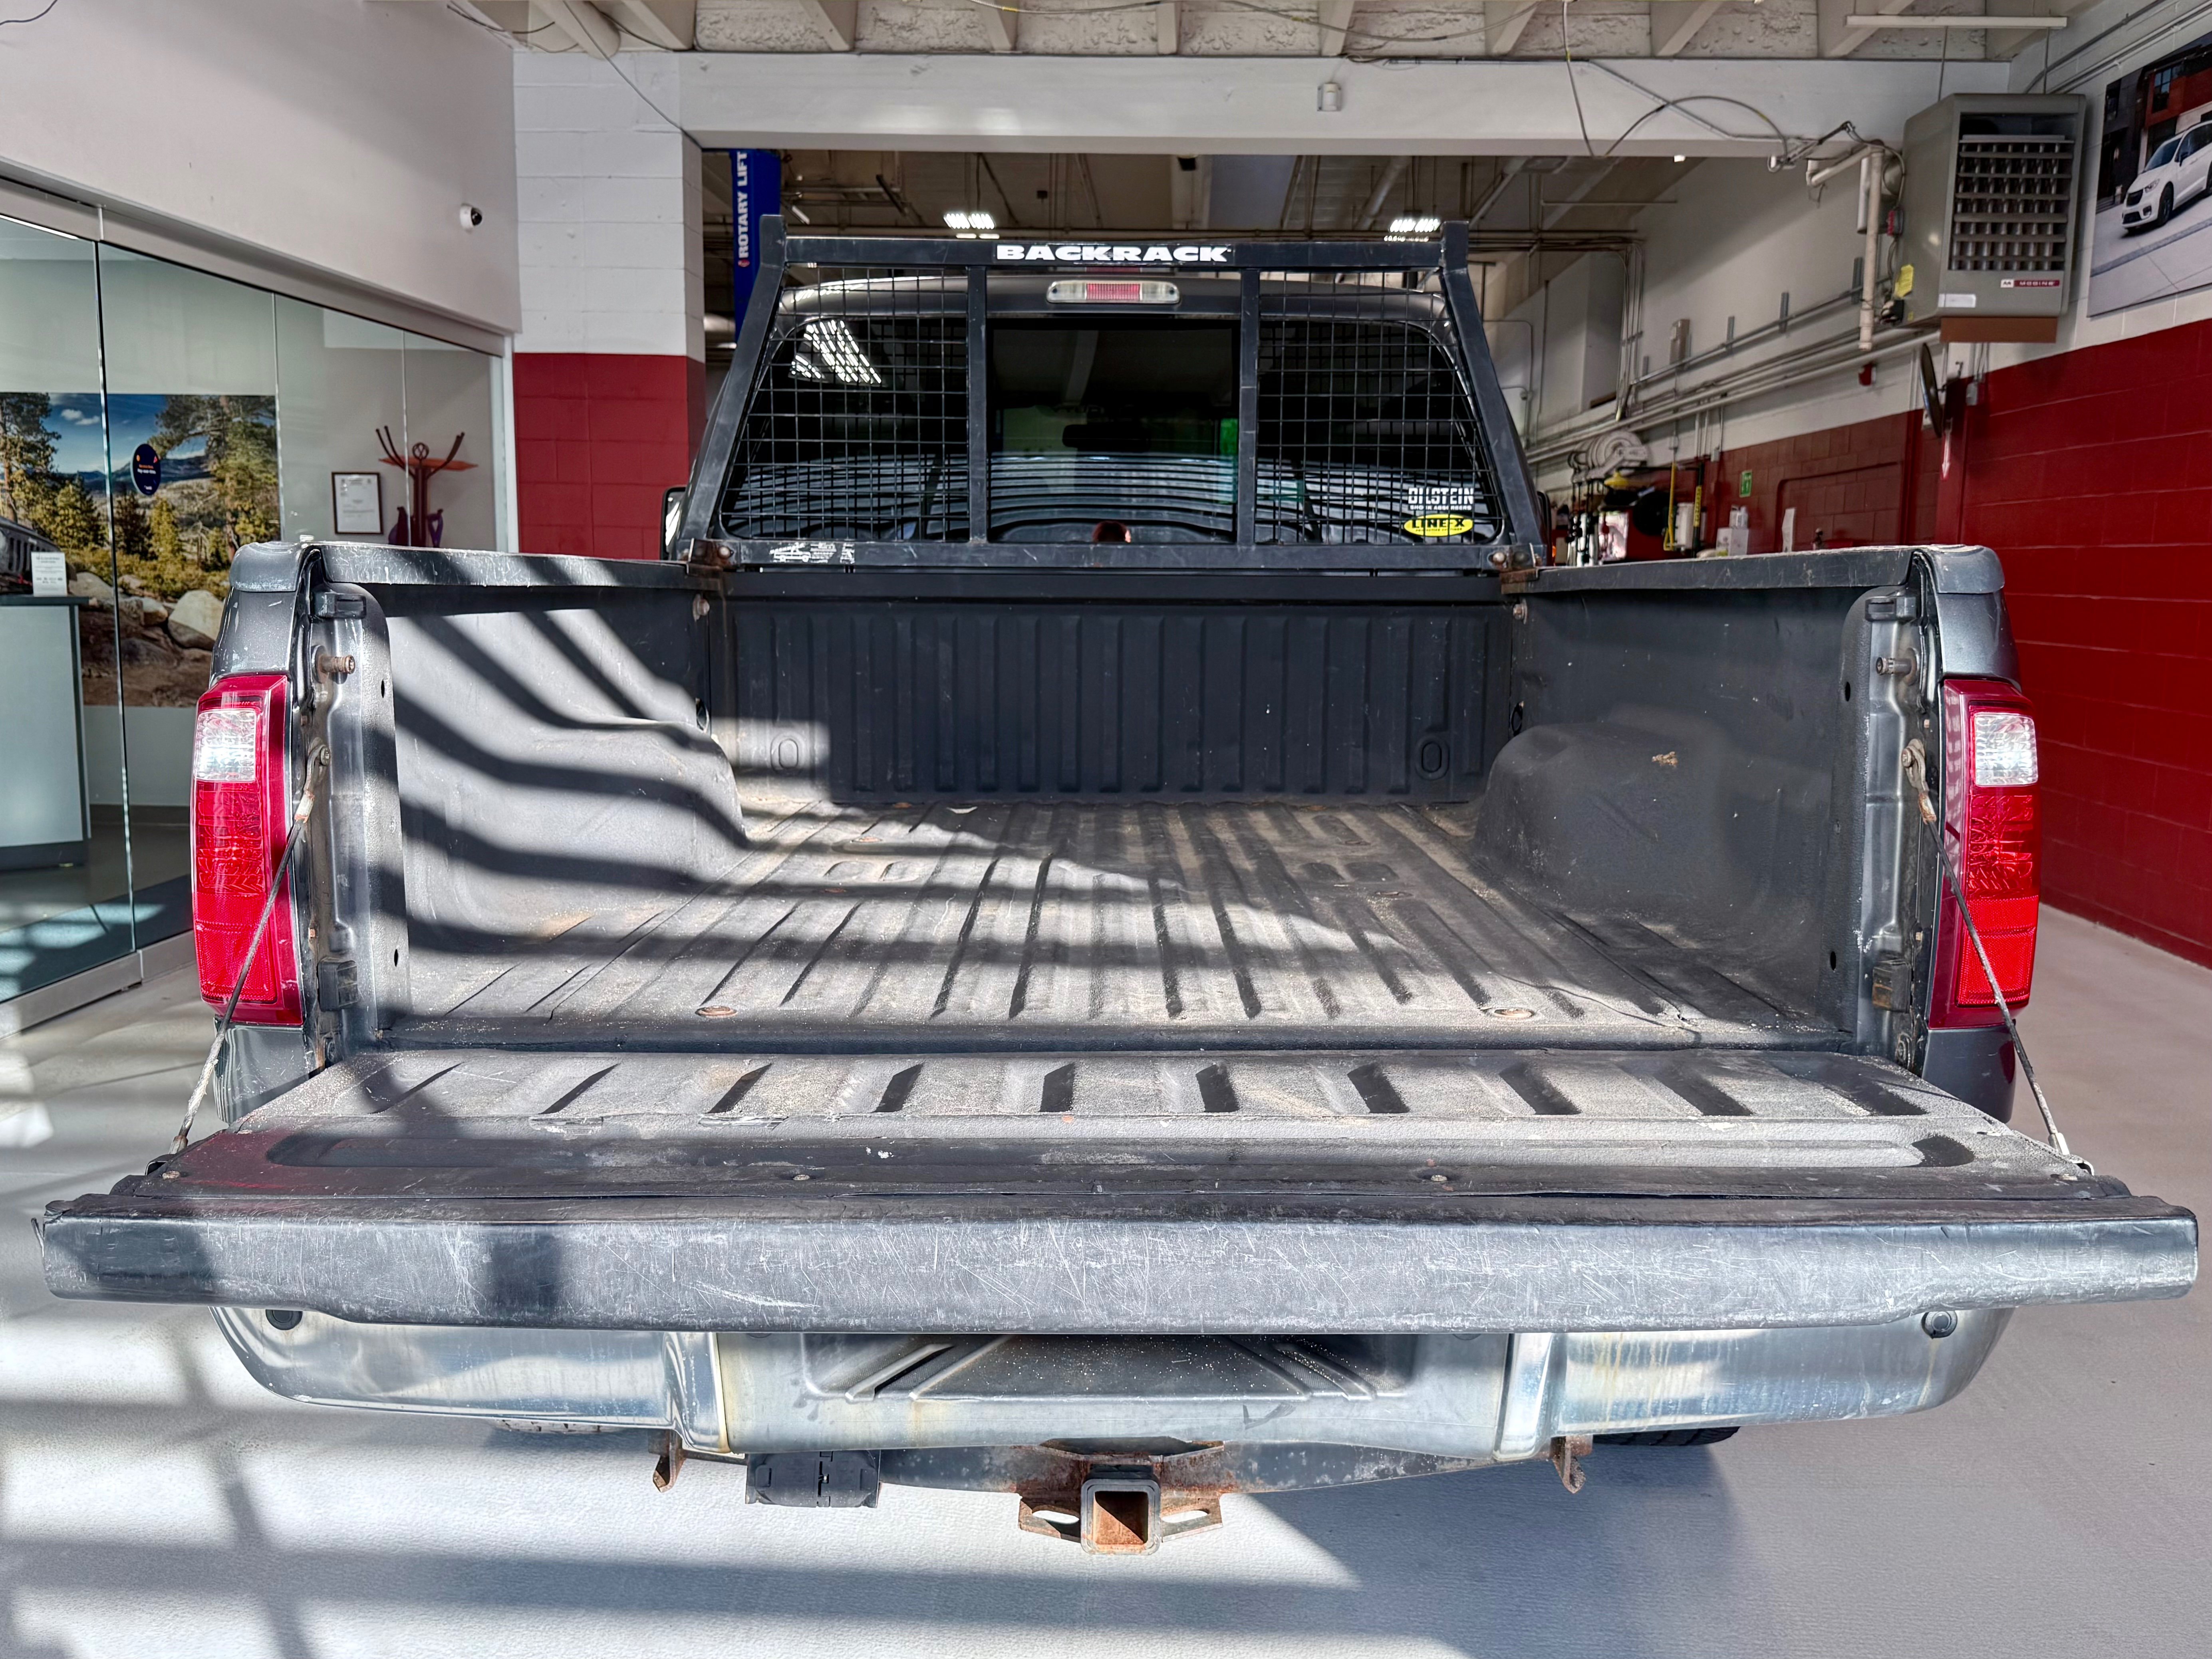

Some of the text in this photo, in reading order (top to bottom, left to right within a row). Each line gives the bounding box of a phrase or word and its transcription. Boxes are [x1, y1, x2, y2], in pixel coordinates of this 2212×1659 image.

[737, 151, 749, 258] ROTARY LIFT
[997, 244, 1228, 262] BACKRACK
[1408, 487, 1474, 505] BILSTEIN
[1412, 518, 1465, 528] LINE-X
